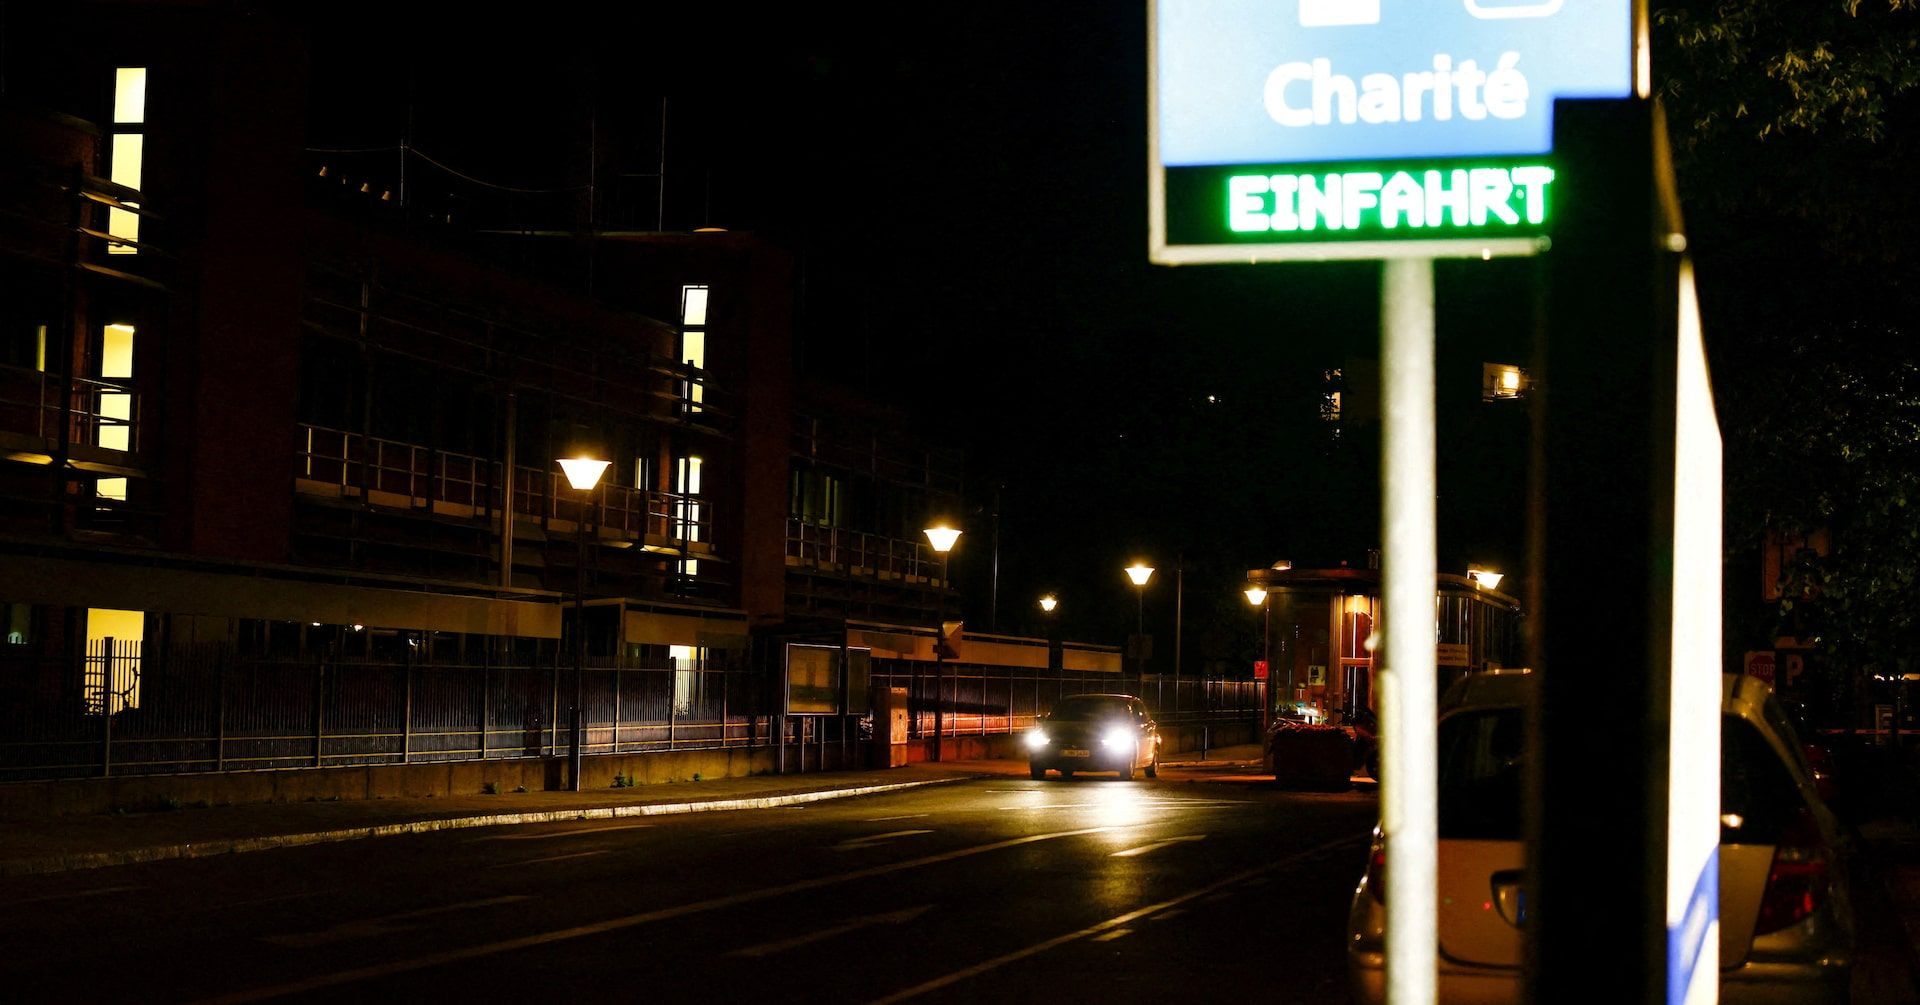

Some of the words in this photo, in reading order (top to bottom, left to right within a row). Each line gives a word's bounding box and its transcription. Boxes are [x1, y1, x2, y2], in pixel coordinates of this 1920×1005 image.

[1263, 52, 1529, 127] Charité
[1228, 166, 1554, 232] EINFAHRT
[1750, 663, 1776, 676] STOP
[1786, 654, 1804, 687] P
